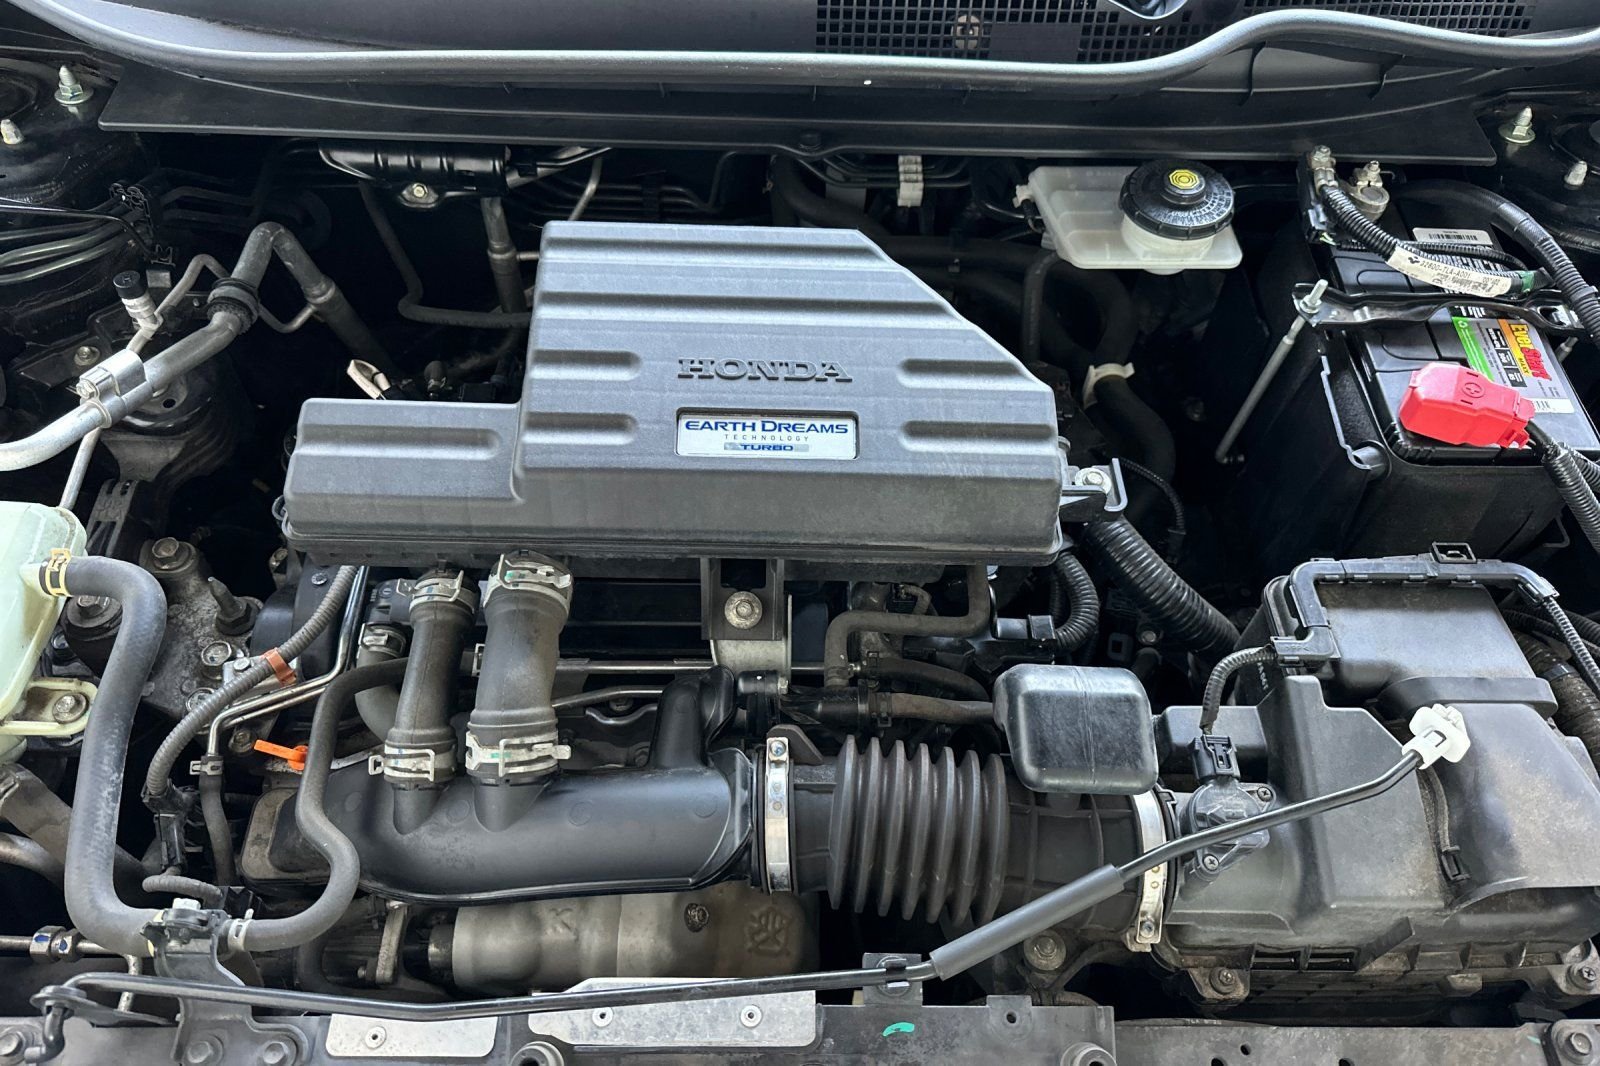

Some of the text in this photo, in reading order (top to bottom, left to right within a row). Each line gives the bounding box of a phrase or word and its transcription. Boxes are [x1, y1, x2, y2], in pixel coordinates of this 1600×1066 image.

[678, 357, 853, 383] HONDA
[685, 420, 849, 434] EARTH DREAMS
[725, 434, 809, 442] TECHNOLOGY
